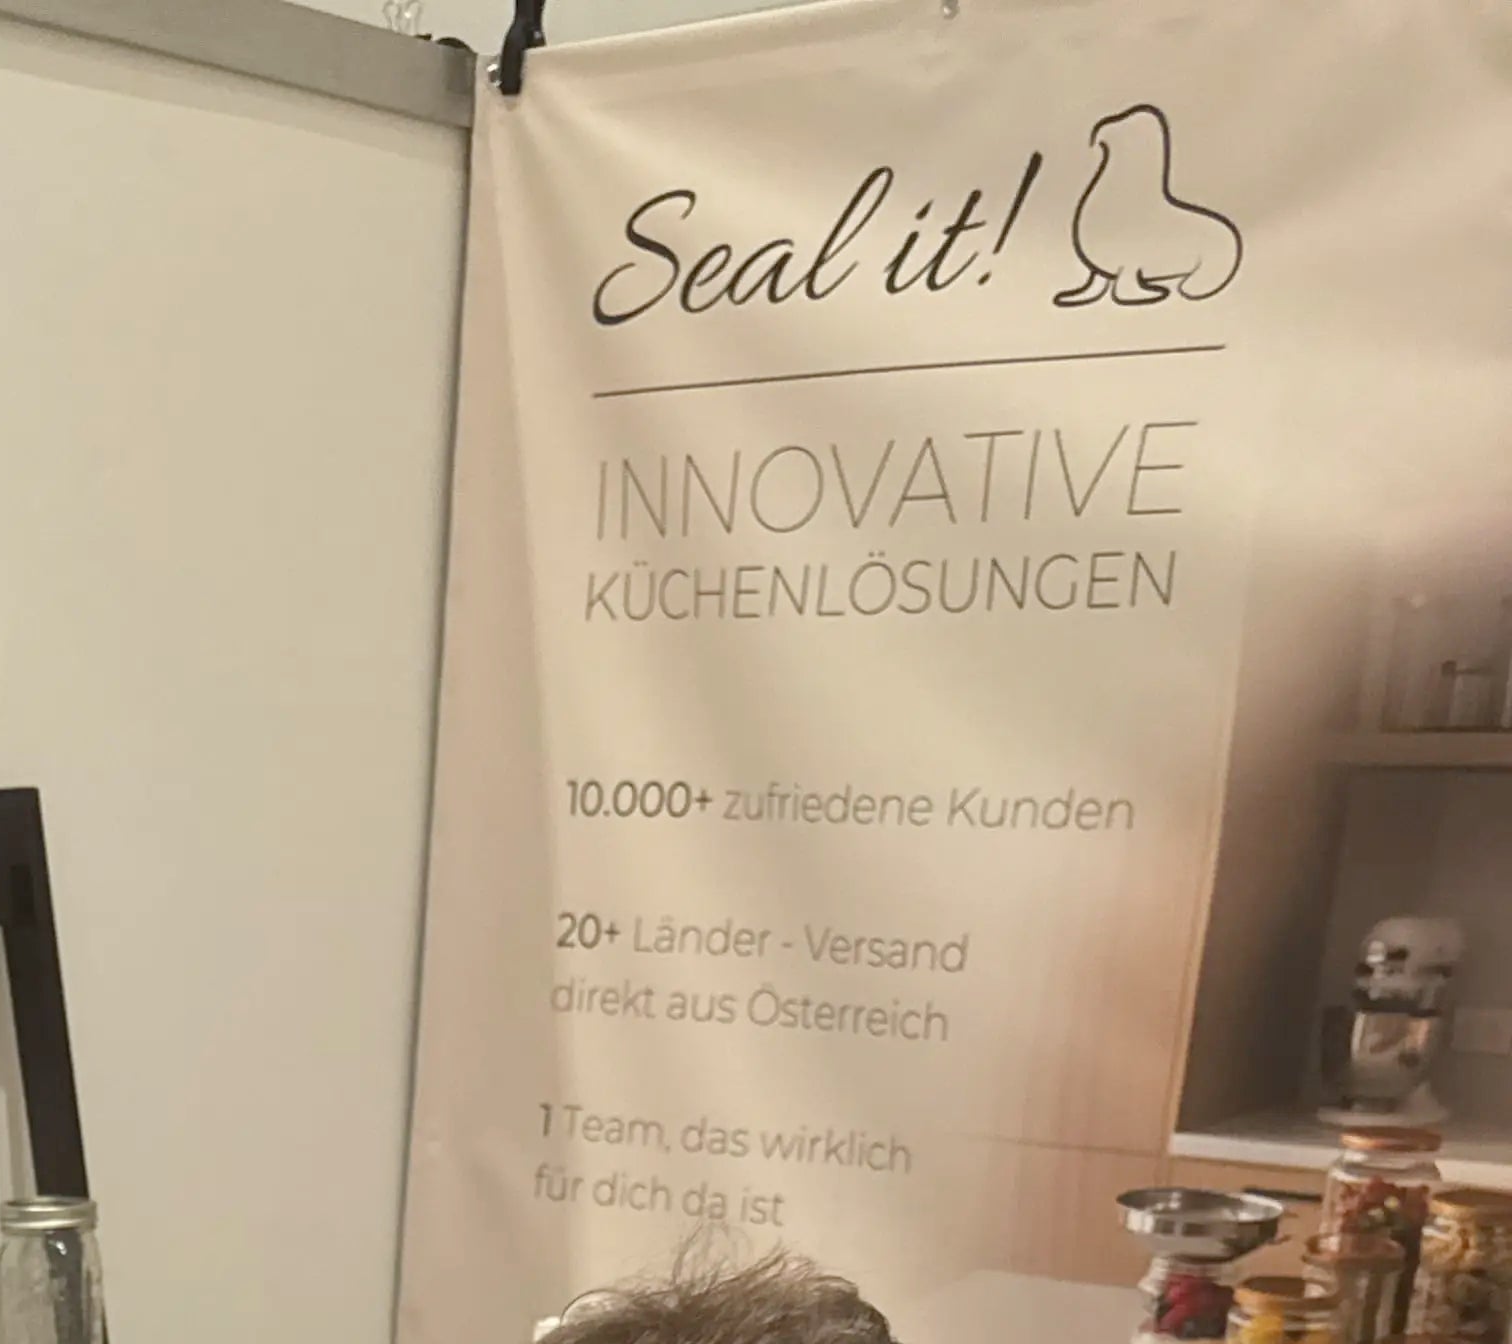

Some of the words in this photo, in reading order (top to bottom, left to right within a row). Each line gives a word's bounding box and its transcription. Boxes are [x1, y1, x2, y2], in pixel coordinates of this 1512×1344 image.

[592, 165, 894, 326] Seal
[884, 150, 1043, 295] it!
[594, 421, 1198, 541] INNOVATIVE
[584, 550, 1177, 623] KÜCHENLÖSUNGEN
[564, 779, 713, 819] 10.000+
[722, 783, 933, 828] zufriedene
[946, 787, 1136, 831] Kunden
[555, 912, 622, 950] 20+
[633, 914, 772, 958] Länder
[805, 925, 969, 973] Versand
[550, 976, 656, 1020] direkt
[667, 993, 737, 1025] aus
[747, 982, 950, 1043] Österreich
[539, 1103, 553, 1138] 1
[563, 1105, 671, 1154] Team,
[680, 1117, 750, 1158] das
[760, 1126, 912, 1174] wirklich
[534, 1163, 584, 1202] für
[592, 1171, 672, 1212] dich
[681, 1182, 728, 1220] da
[739, 1187, 785, 1226] ist
